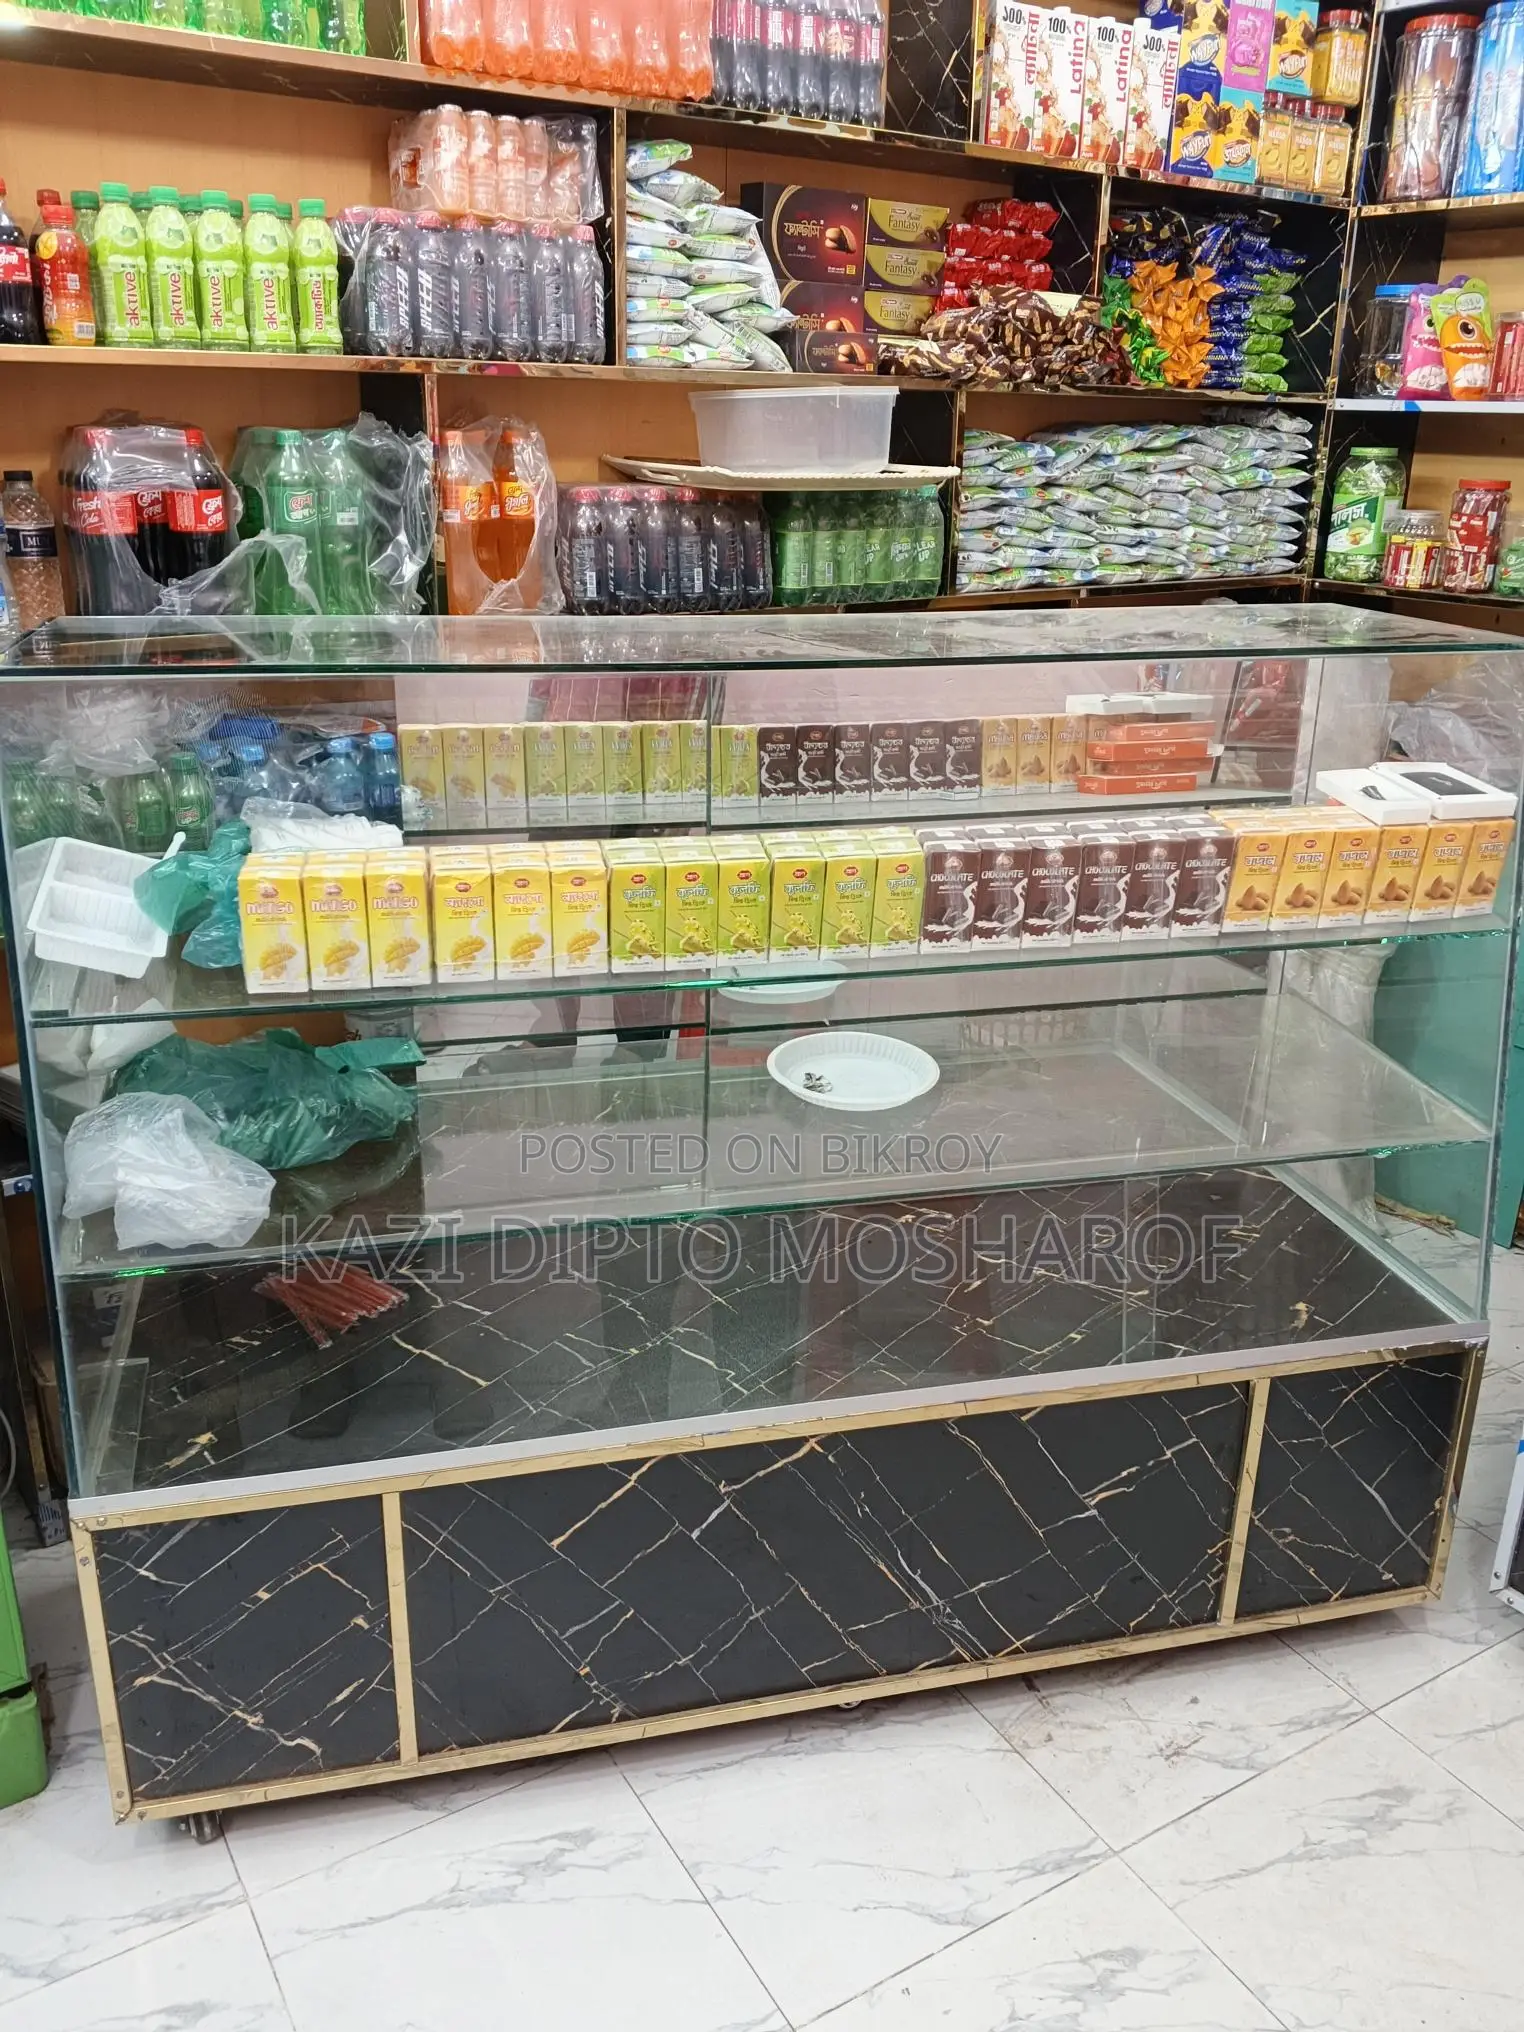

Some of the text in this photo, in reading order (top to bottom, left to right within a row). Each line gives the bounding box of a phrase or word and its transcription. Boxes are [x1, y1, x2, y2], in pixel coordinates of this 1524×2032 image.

[1069, 20, 1085, 95] Latina
[1115, 30, 1132, 103] Latina
[888, 214, 921, 232] Fantasy
[884, 260, 918, 276] Fantasy
[126, 271, 139, 327] aktive
[169, 272, 185, 326] aktive
[210, 275, 223, 327] aktive
[263, 278, 279, 331] aktive
[396, 265, 409, 330] SPEED
[418, 267, 433, 332] SPEED
[879, 305, 911, 320] Fantasy
[1032, 866, 1075, 876] CHOCOLATE
[1085, 865, 1128, 875] CHOCOLATE
[1135, 861, 1178, 871] CHOCOLATE
[1185, 858, 1228, 868] CHOCOLATE
[931, 873, 974, 883] CHOCOLATE
[981, 869, 1024, 880] CHOCOLATE
